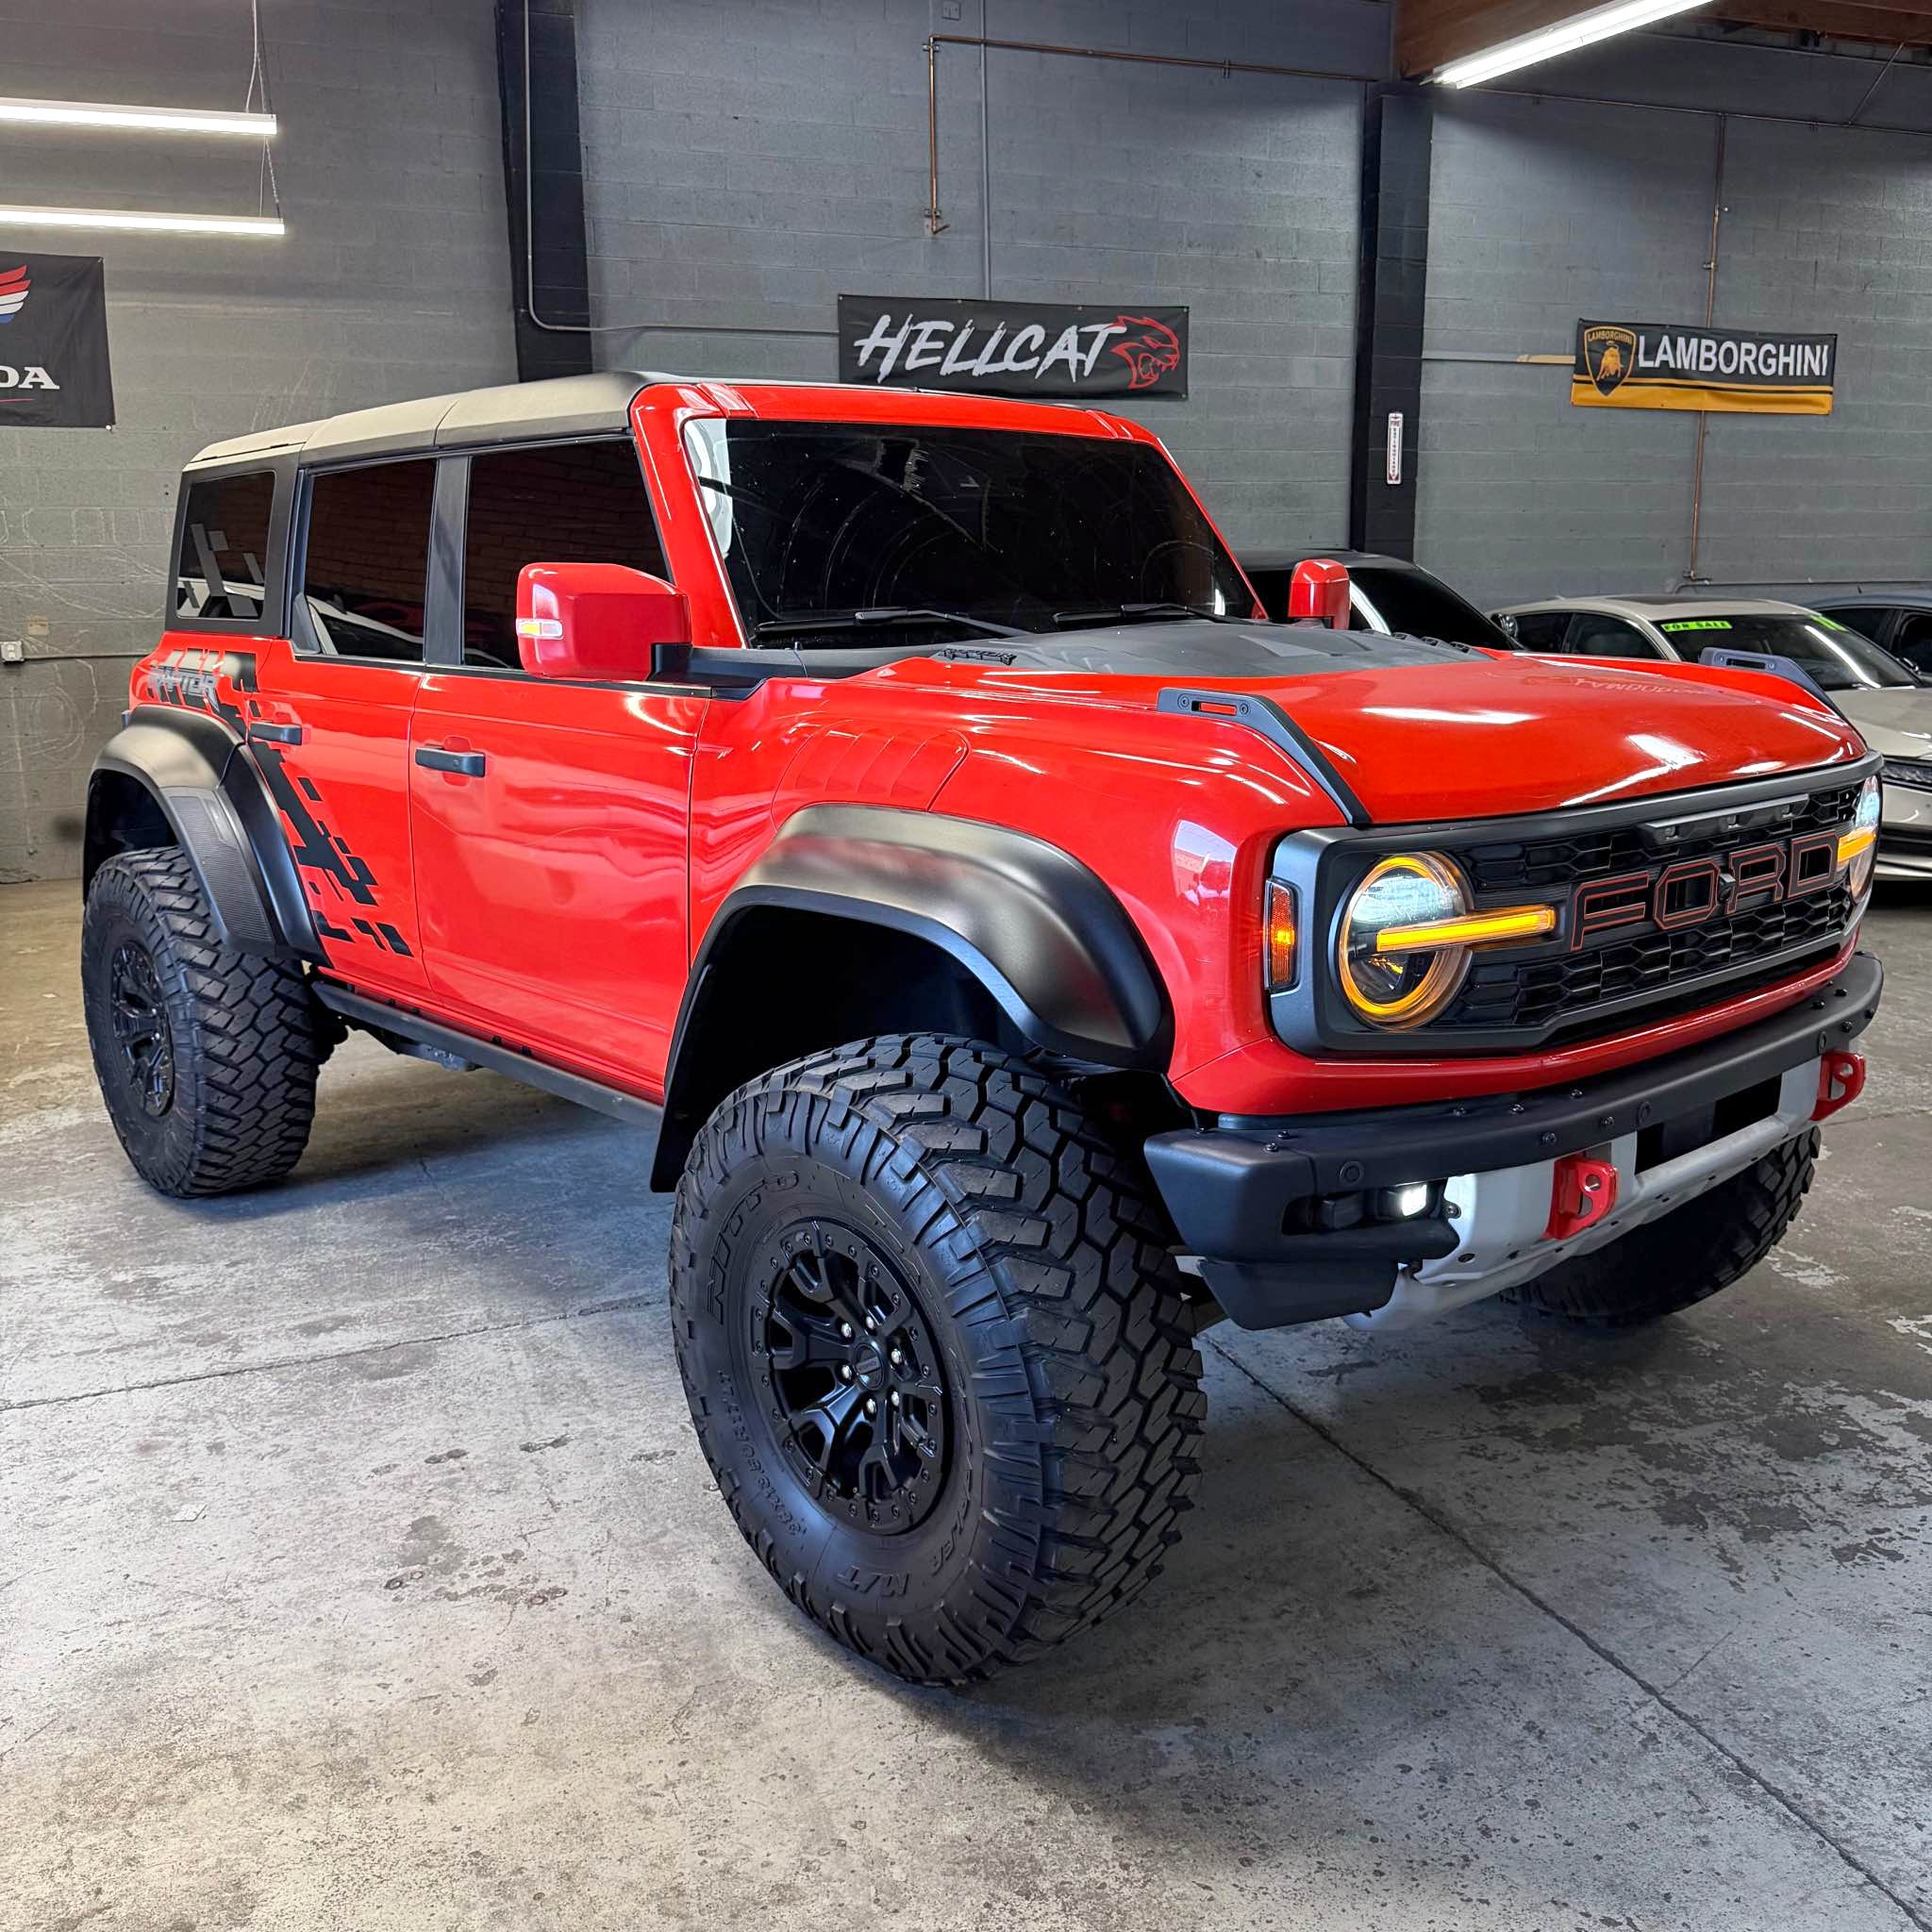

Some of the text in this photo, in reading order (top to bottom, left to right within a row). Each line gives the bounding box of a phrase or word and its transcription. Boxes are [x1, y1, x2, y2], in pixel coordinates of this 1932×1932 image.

[854, 314, 1127, 383] HELLCAT
[1588, 330, 1632, 344] LAMBORGHINI
[1638, 335, 1829, 376] LAMBORGHINI
[1663, 623, 1690, 631] FOR
[1570, 829, 1840, 952] FORD
